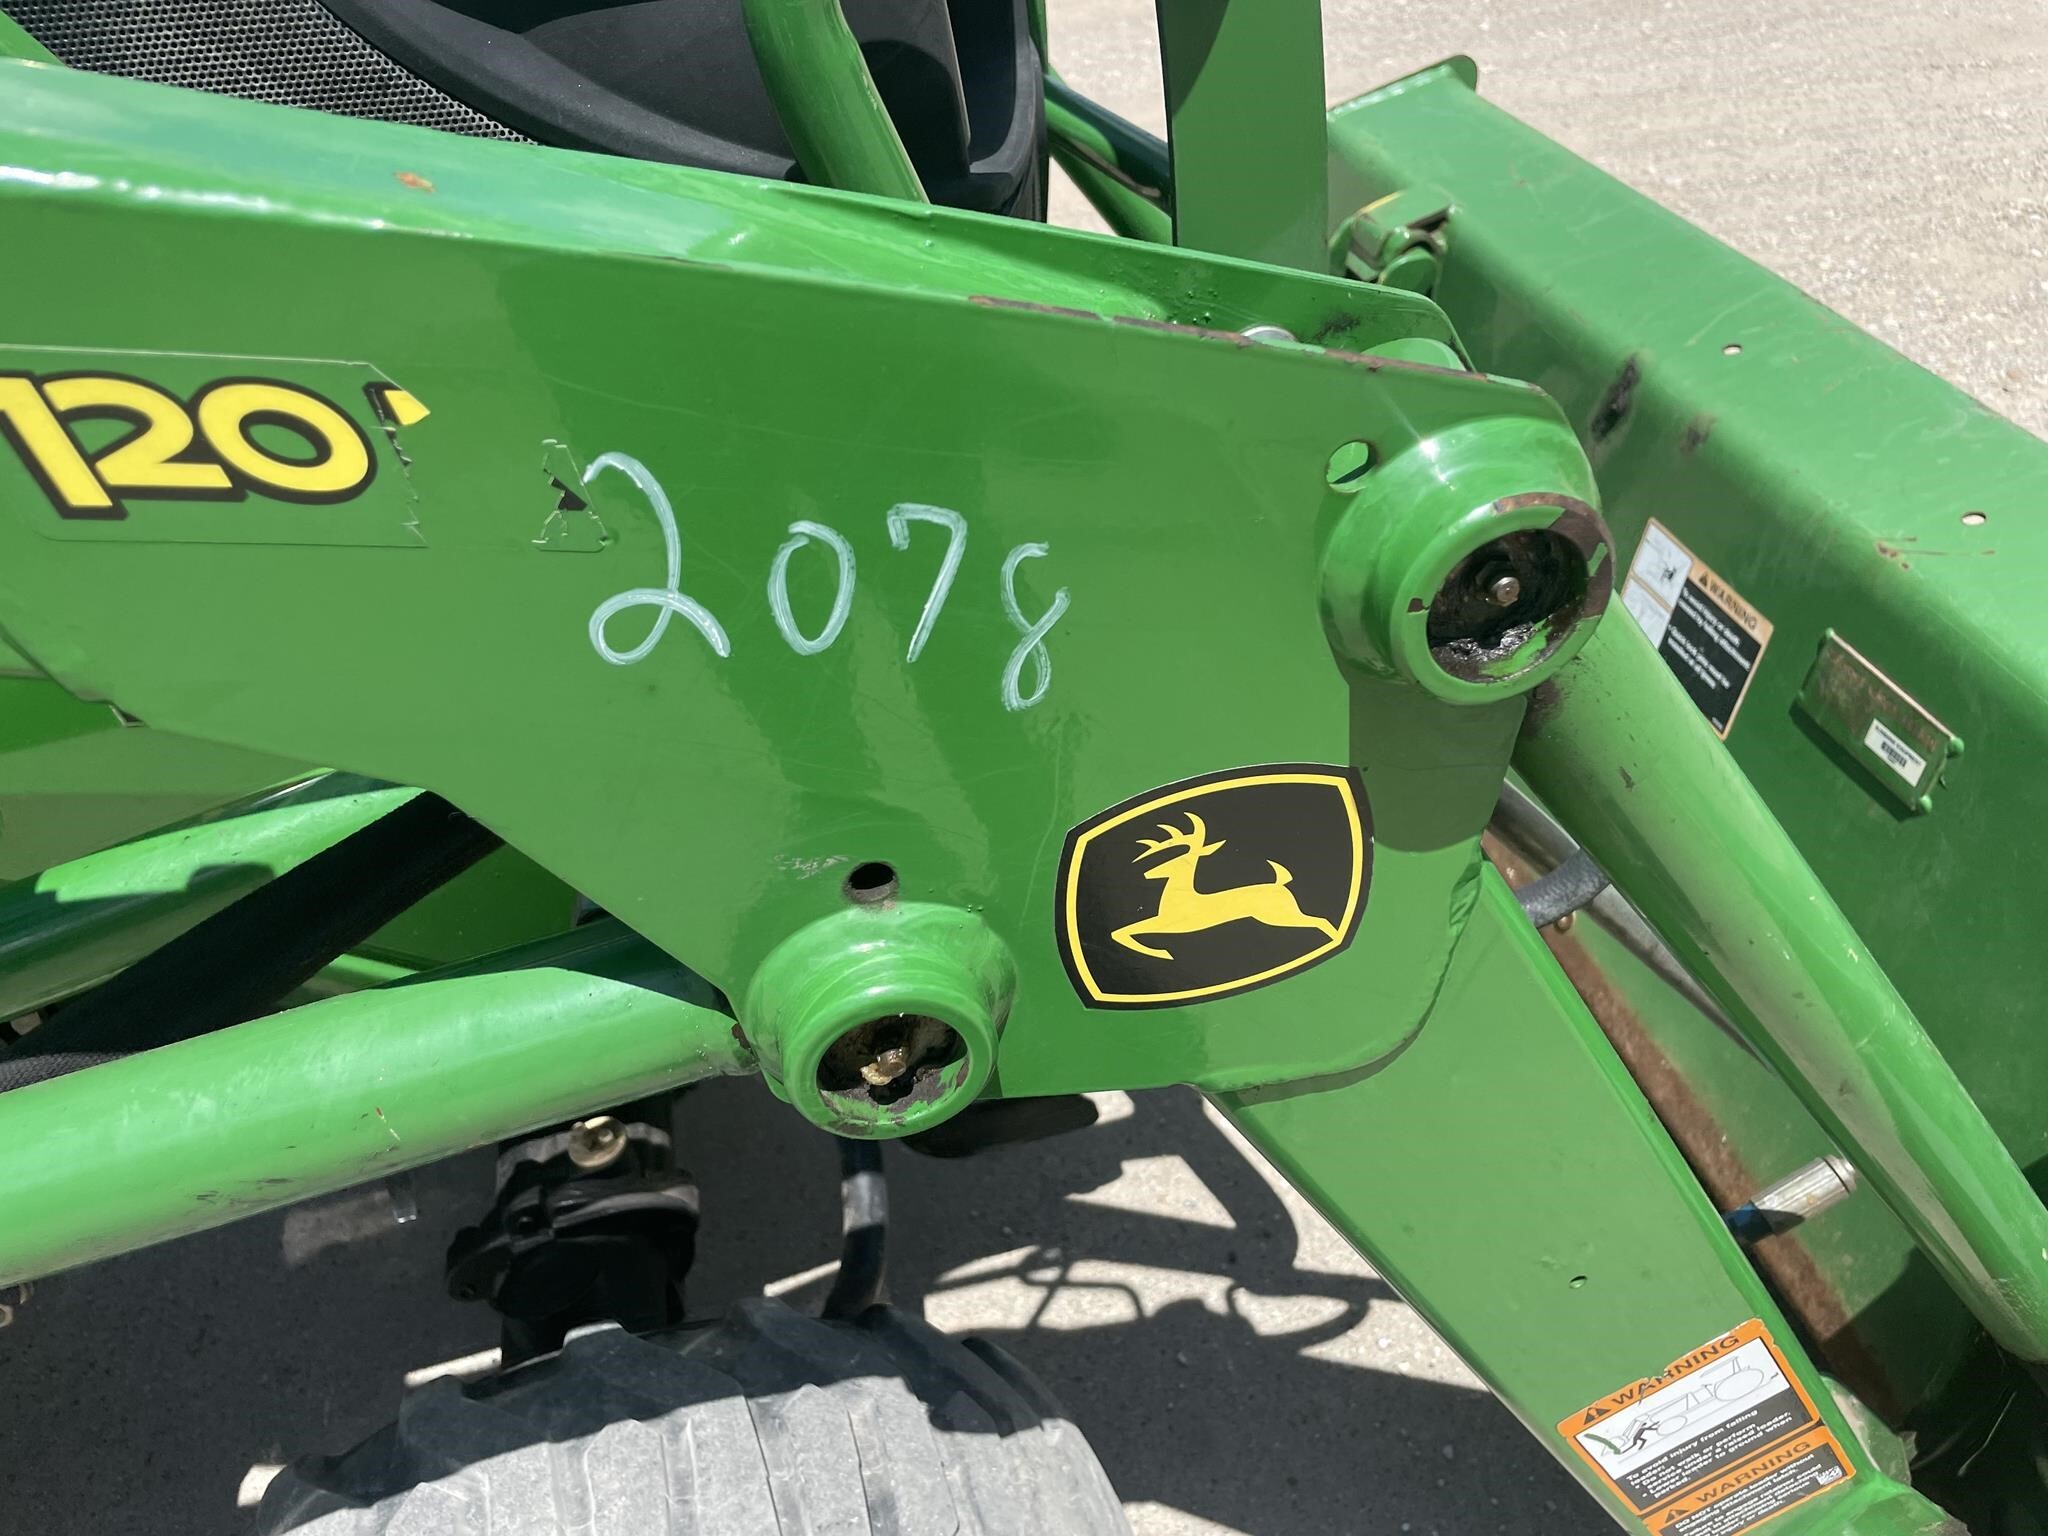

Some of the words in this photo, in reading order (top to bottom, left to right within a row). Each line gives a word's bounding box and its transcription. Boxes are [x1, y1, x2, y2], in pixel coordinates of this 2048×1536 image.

[582, 451, 1071, 712] 2078
[1709, 583, 1757, 631] WARNING
[1626, 1472, 1639, 1481] To
[1641, 1457, 1668, 1473] avoid
[1670, 1440, 1698, 1459] injury
[1700, 1427, 1724, 1443] from
[1726, 1409, 1758, 1429] falling
[1642, 1476, 1657, 1486] Do
[1658, 1463, 1676, 1477] not
[1677, 1452, 1701, 1467] walk
[1715, 1424, 1756, 1448] perform
[1647, 1470, 1681, 1489] service
[1684, 1452, 1713, 1469] under
[1723, 1430, 1755, 1452] raised
[1757, 1411, 1791, 1431] loader.
[1650, 1474, 1679, 1494] Lower
[1682, 1457, 1713, 1476] loader
[1728, 1431, 1764, 1454] ground
[1765, 1416, 1793, 1434] when
[1696, 1443, 1811, 1503] WARNING
[1654, 1476, 1691, 1499] parked.
[1691, 1506, 1711, 1520] NOT
[1779, 1453, 1814, 1474] without
